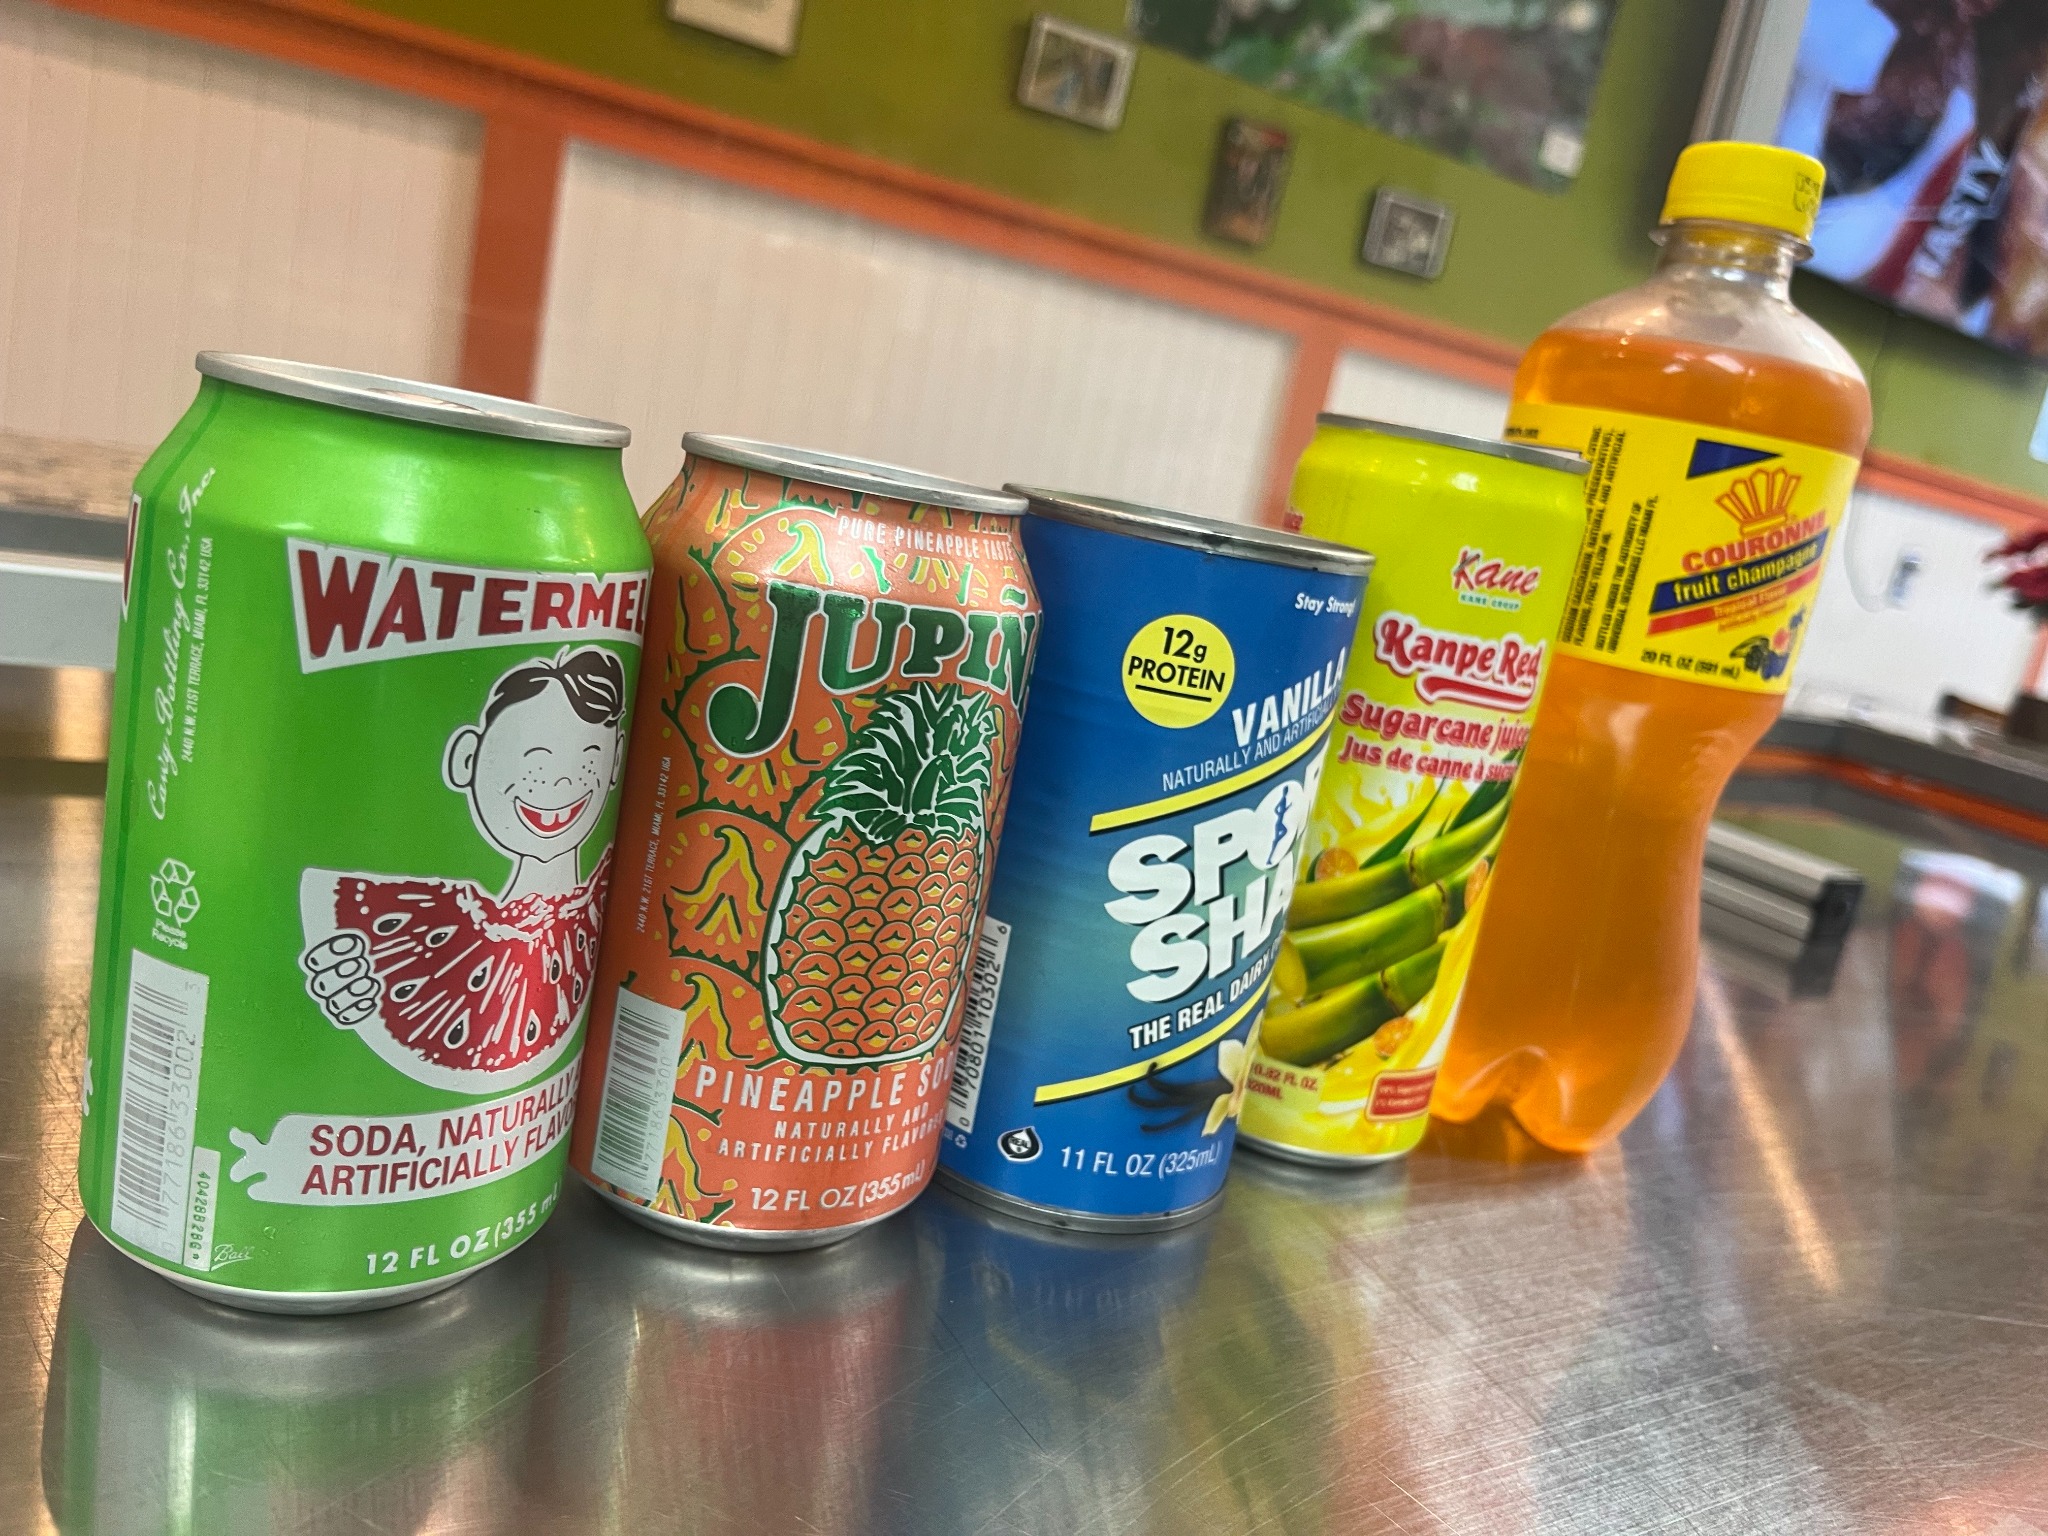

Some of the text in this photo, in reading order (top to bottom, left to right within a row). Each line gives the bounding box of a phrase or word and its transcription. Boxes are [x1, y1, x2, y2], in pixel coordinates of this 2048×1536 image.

[200, 537, 213, 558] USA
[837, 515, 1015, 562] PURE PINEAPPLE TASTE
[197, 557, 212, 590] 33142
[1453, 550, 1539, 596] Kane
[1673, 573, 1721, 604] fruit
[1726, 543, 1819, 591] champagne
[195, 594, 208, 606] FL
[1294, 592, 1325, 616] Stay
[192, 607, 208, 640] MIAMI,
[1163, 626, 1208, 663] 12g
[155, 592, 191, 736] Bottling
[188, 642, 204, 686] TERRACE,
[1379, 618, 1496, 678] Kanpe
[1128, 656, 1226, 693] PROTEIN
[1232, 647, 1346, 747] VANILLA
[186, 688, 200, 713] 21ST
[1341, 693, 1494, 747] Sugarcane
[181, 737, 195, 763] 2440
[1162, 746, 1252, 792] NATURALLY
[1254, 734, 1281, 761] AND
[1339, 735, 1383, 764] Jus
[1387, 746, 1413, 772] de
[1416, 754, 1473, 779] canne
[156, 918, 187, 939] Please
[977, 959, 1001, 1019] 10302
[1129, 949, 1270, 1050] THE REAL DAIRY
[170, 1028, 197, 1118] 33002
[695, 1064, 907, 1113] PINEAPPLE
[308, 1122, 428, 1157] SODA,
[438, 1067, 574, 1150] NATURALLY
[774, 1102, 929, 1140] NATURALLY AND
[161, 1124, 187, 1207] 77186
[301, 1136, 519, 1196] ARTIFICIALLY
[718, 1138, 875, 1164] ARTIFICIALLY
[1061, 1146, 1086, 1170] 11
[1093, 1151, 1118, 1175] FL
[1125, 1153, 1156, 1176] OZ
[751, 1187, 780, 1212] 12
[783, 1189, 811, 1212] FL
[820, 1185, 858, 1209] OZ
[366, 1251, 400, 1275] 12
[410, 1244, 440, 1270] FL
[450, 1226, 491, 1260] OZ
[493, 1201, 538, 1249] (355
